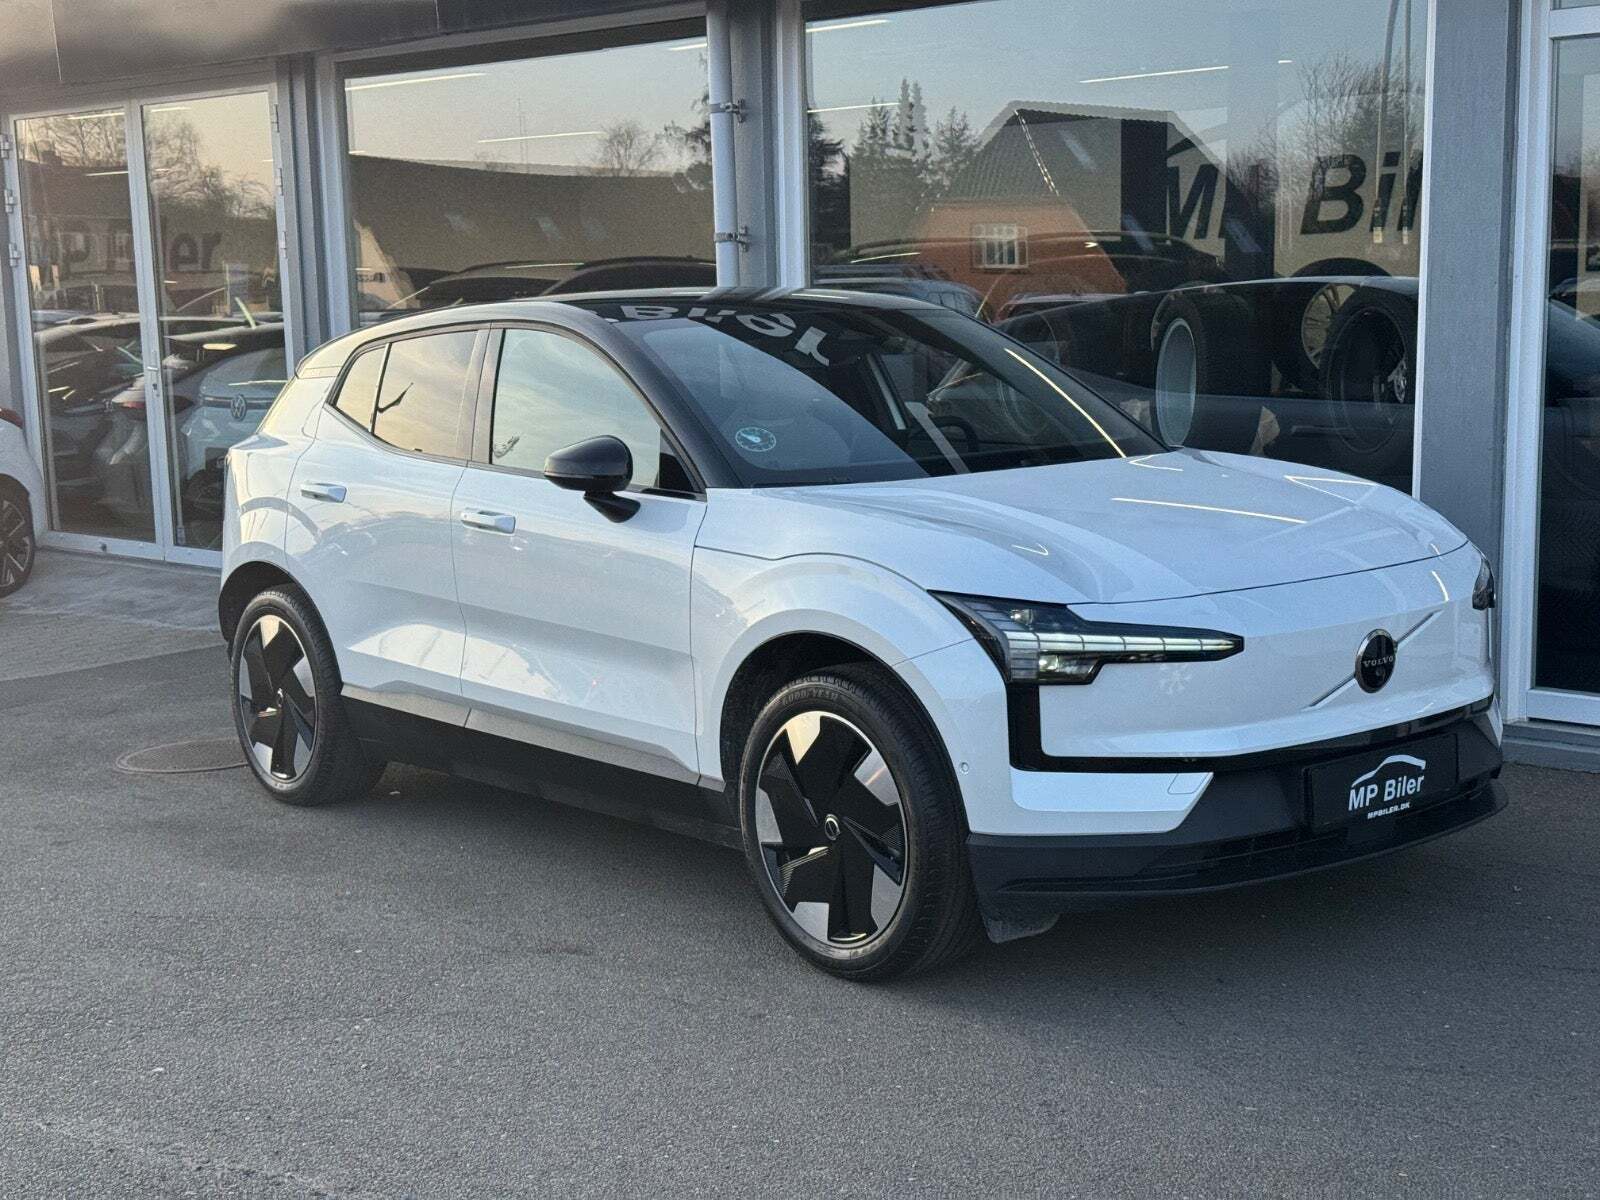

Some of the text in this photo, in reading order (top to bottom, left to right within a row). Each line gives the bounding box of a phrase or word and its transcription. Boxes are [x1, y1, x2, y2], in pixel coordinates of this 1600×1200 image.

[1362, 655, 1394, 668] VOLVO
[1348, 775, 1425, 811] MP Biler
[1367, 801, 1411, 819] MPBILER.DK
